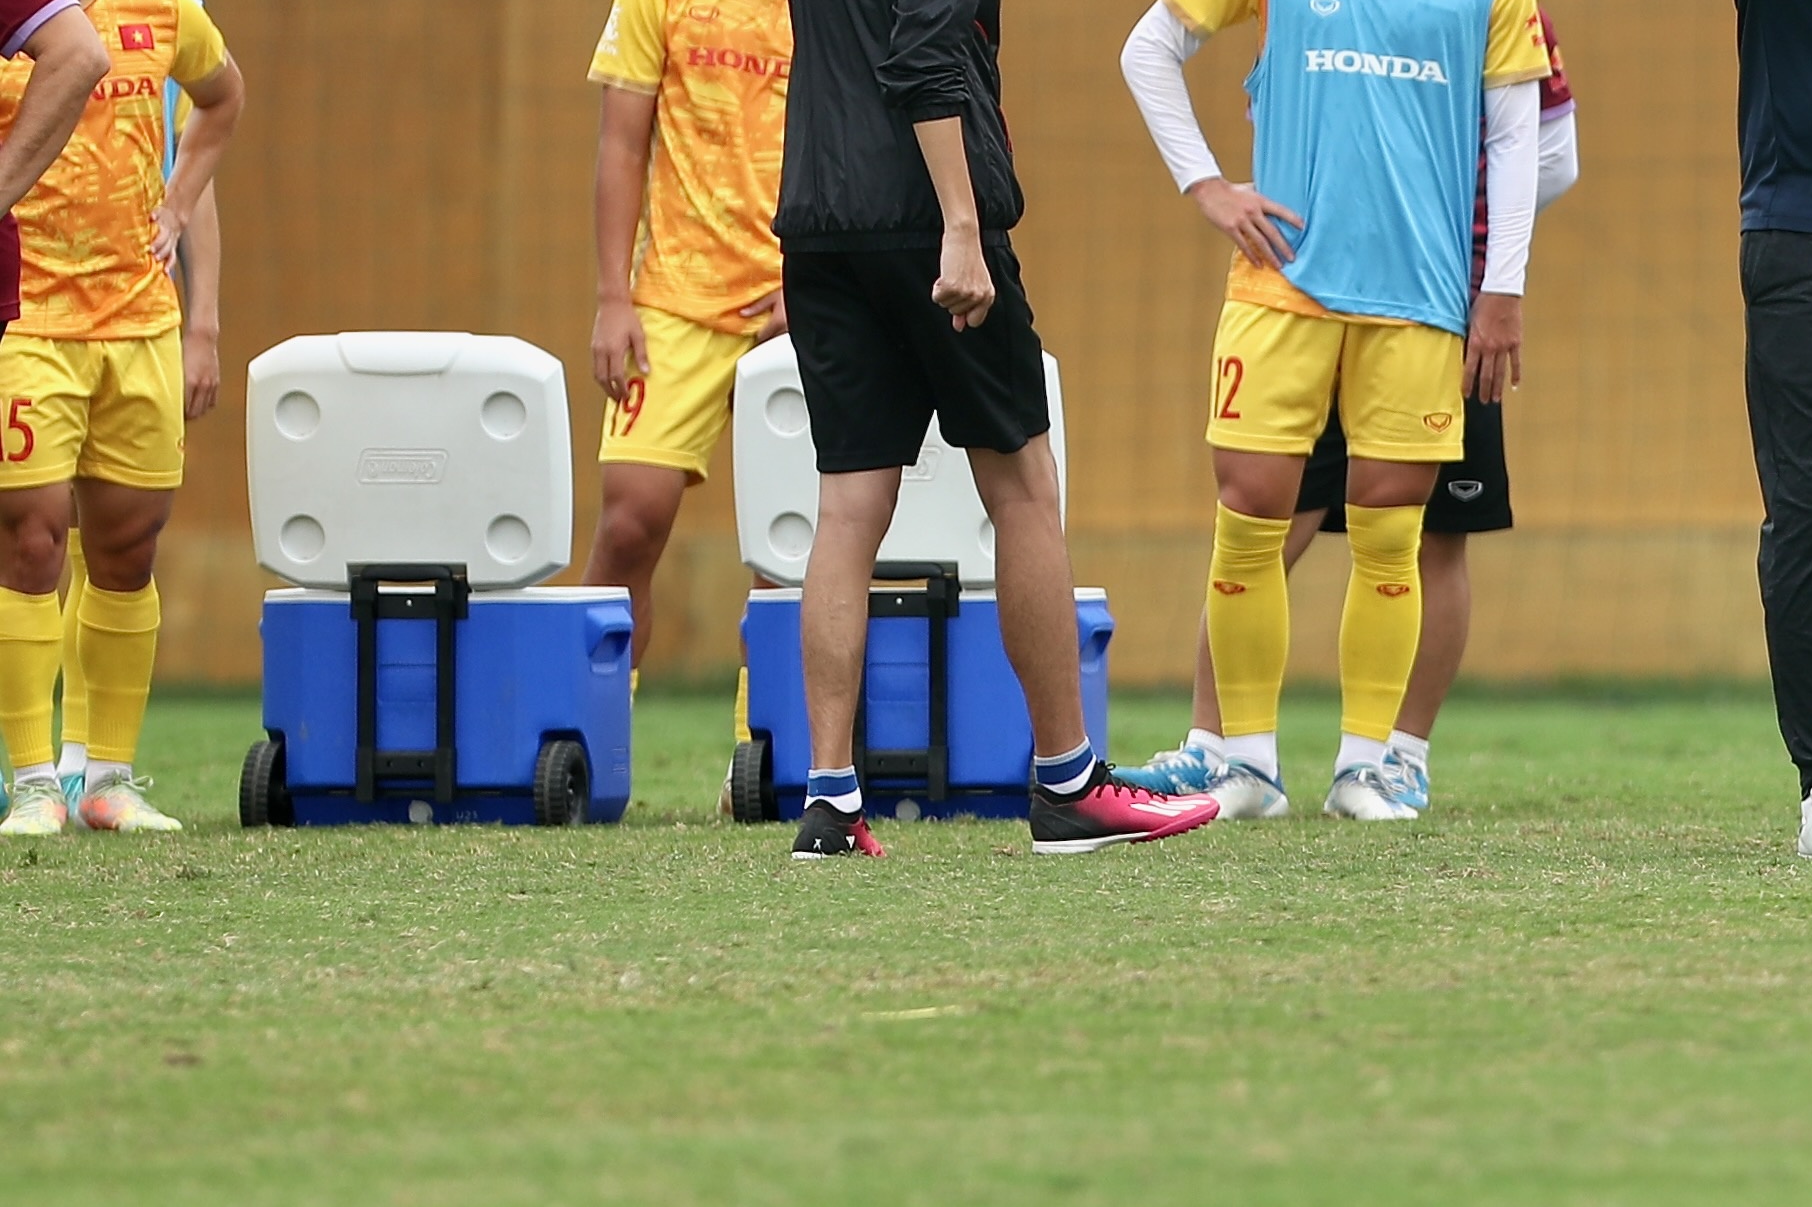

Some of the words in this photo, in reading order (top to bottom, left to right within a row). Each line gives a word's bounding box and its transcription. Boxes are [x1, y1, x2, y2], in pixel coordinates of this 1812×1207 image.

[687, 47, 789, 78] HOND
[1305, 49, 1449, 84] HONDA
[1213, 356, 1244, 419] 12
